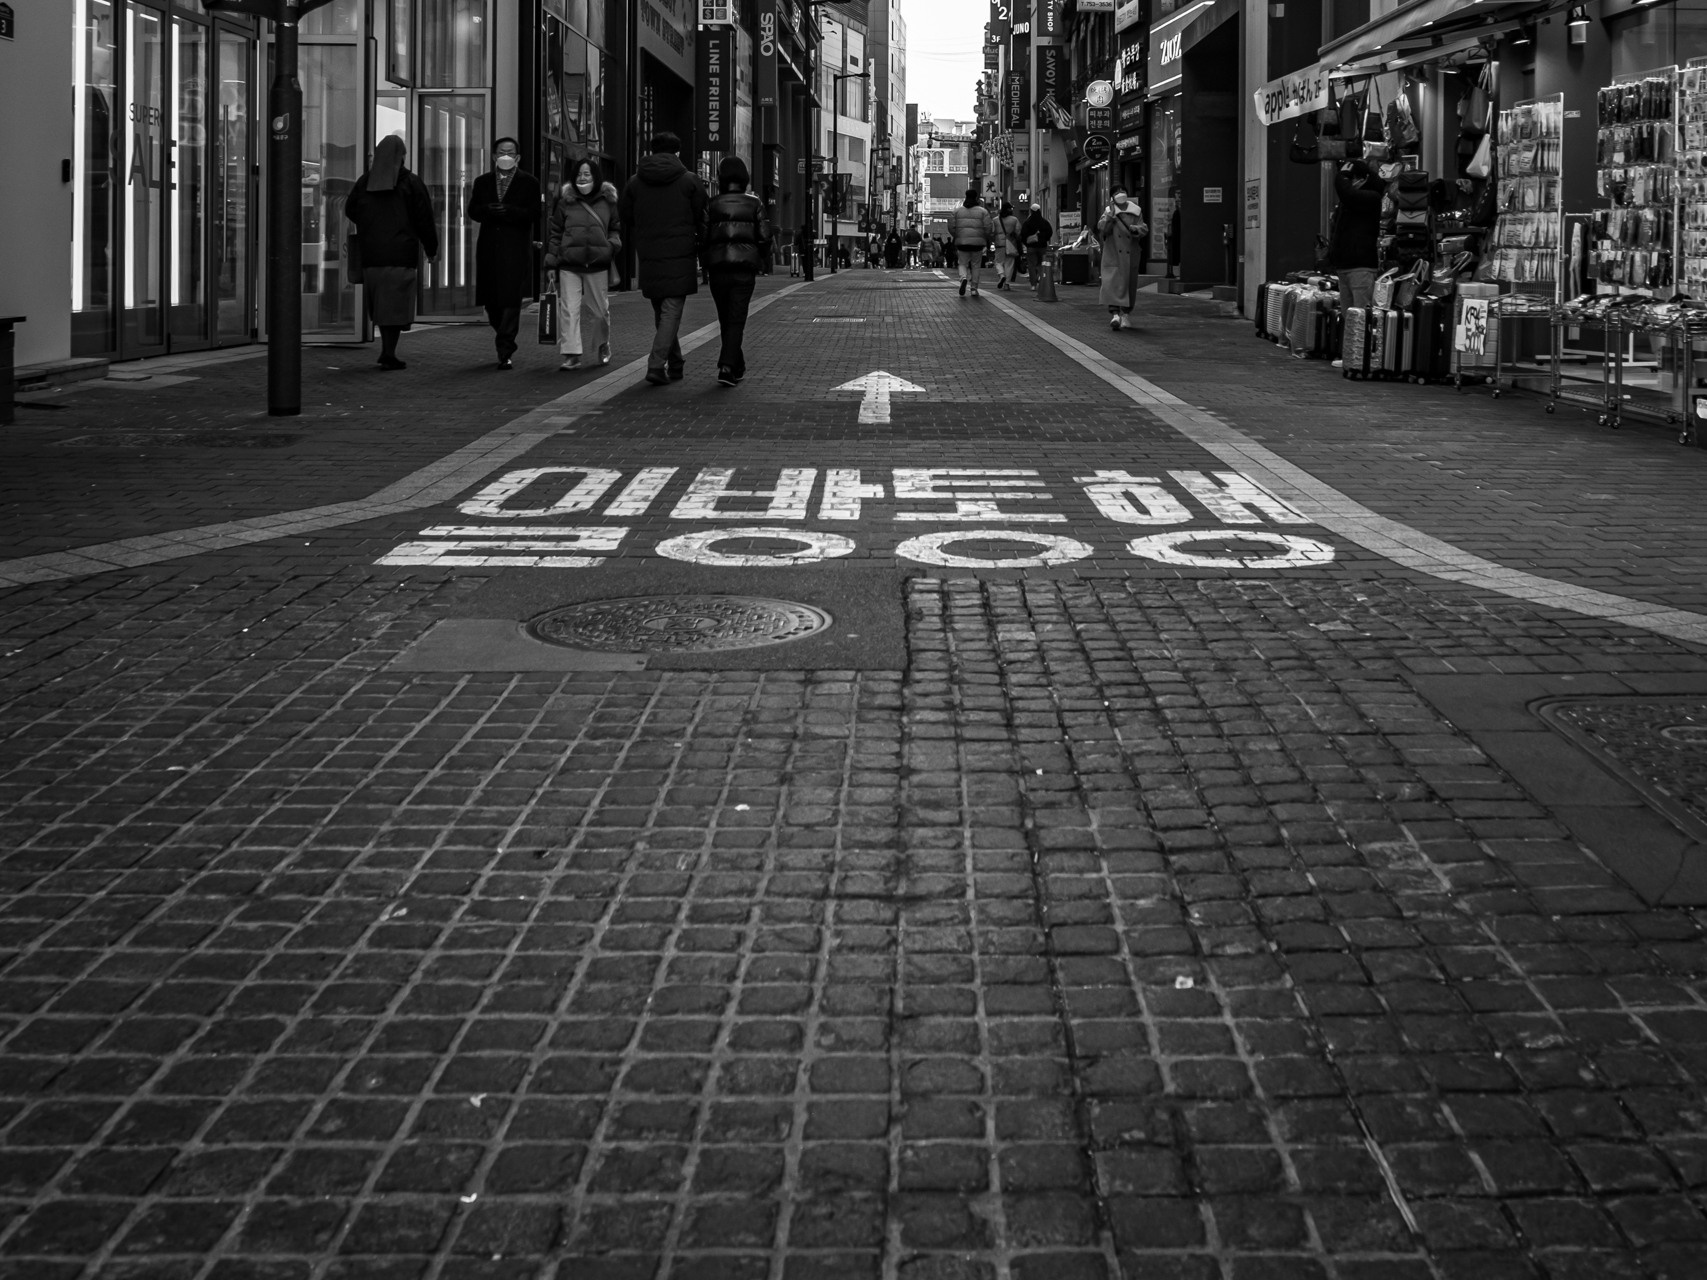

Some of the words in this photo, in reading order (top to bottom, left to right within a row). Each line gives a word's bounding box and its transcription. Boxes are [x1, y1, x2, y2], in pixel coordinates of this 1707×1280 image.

[998, 6, 1008, 21] 2
[1046, 12, 1055, 32] SHOP
[760, 12, 774, 57] SPAO
[991, 35, 1001, 43] 3F
[1012, 21, 1030, 36] JUNO
[709, 40, 720, 74] LINE
[1046, 49, 1056, 85] SAVOY
[129, 102, 160, 126] SUPER
[709, 77, 720, 142] FRIENDS
[1011, 76, 1020, 127] MEDIHEAL
[1089, 110, 1110, 119] 피부과
[1264, 83, 1290, 119] apple
[1089, 119, 1110, 129] 전문의
[108, 129, 177, 191] SALE
[986, 180, 996, 193] 光
[373, 464, 1336, 570] 일방통행
